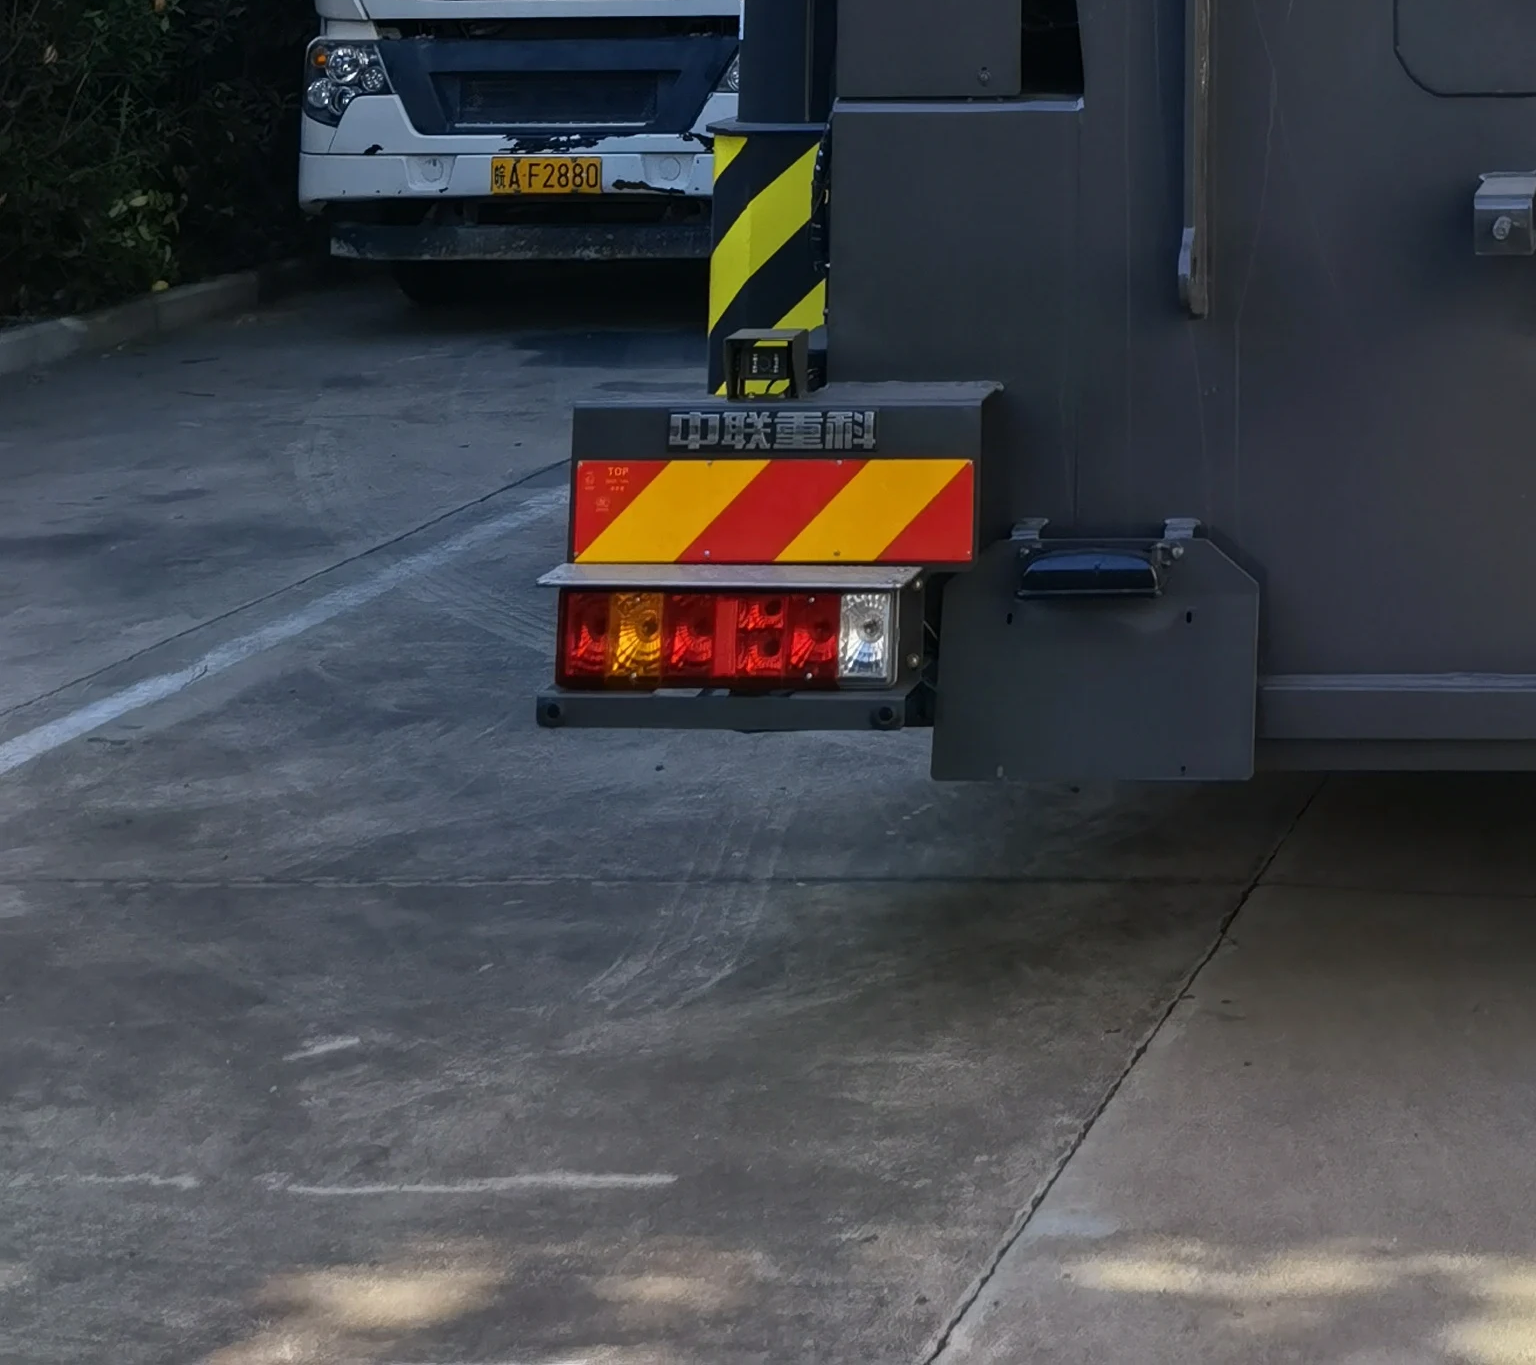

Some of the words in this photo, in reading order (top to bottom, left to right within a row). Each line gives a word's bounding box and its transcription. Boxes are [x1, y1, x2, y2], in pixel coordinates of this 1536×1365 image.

[668, 411, 876, 450] 中联重科
[608, 467, 629, 477] TOP
